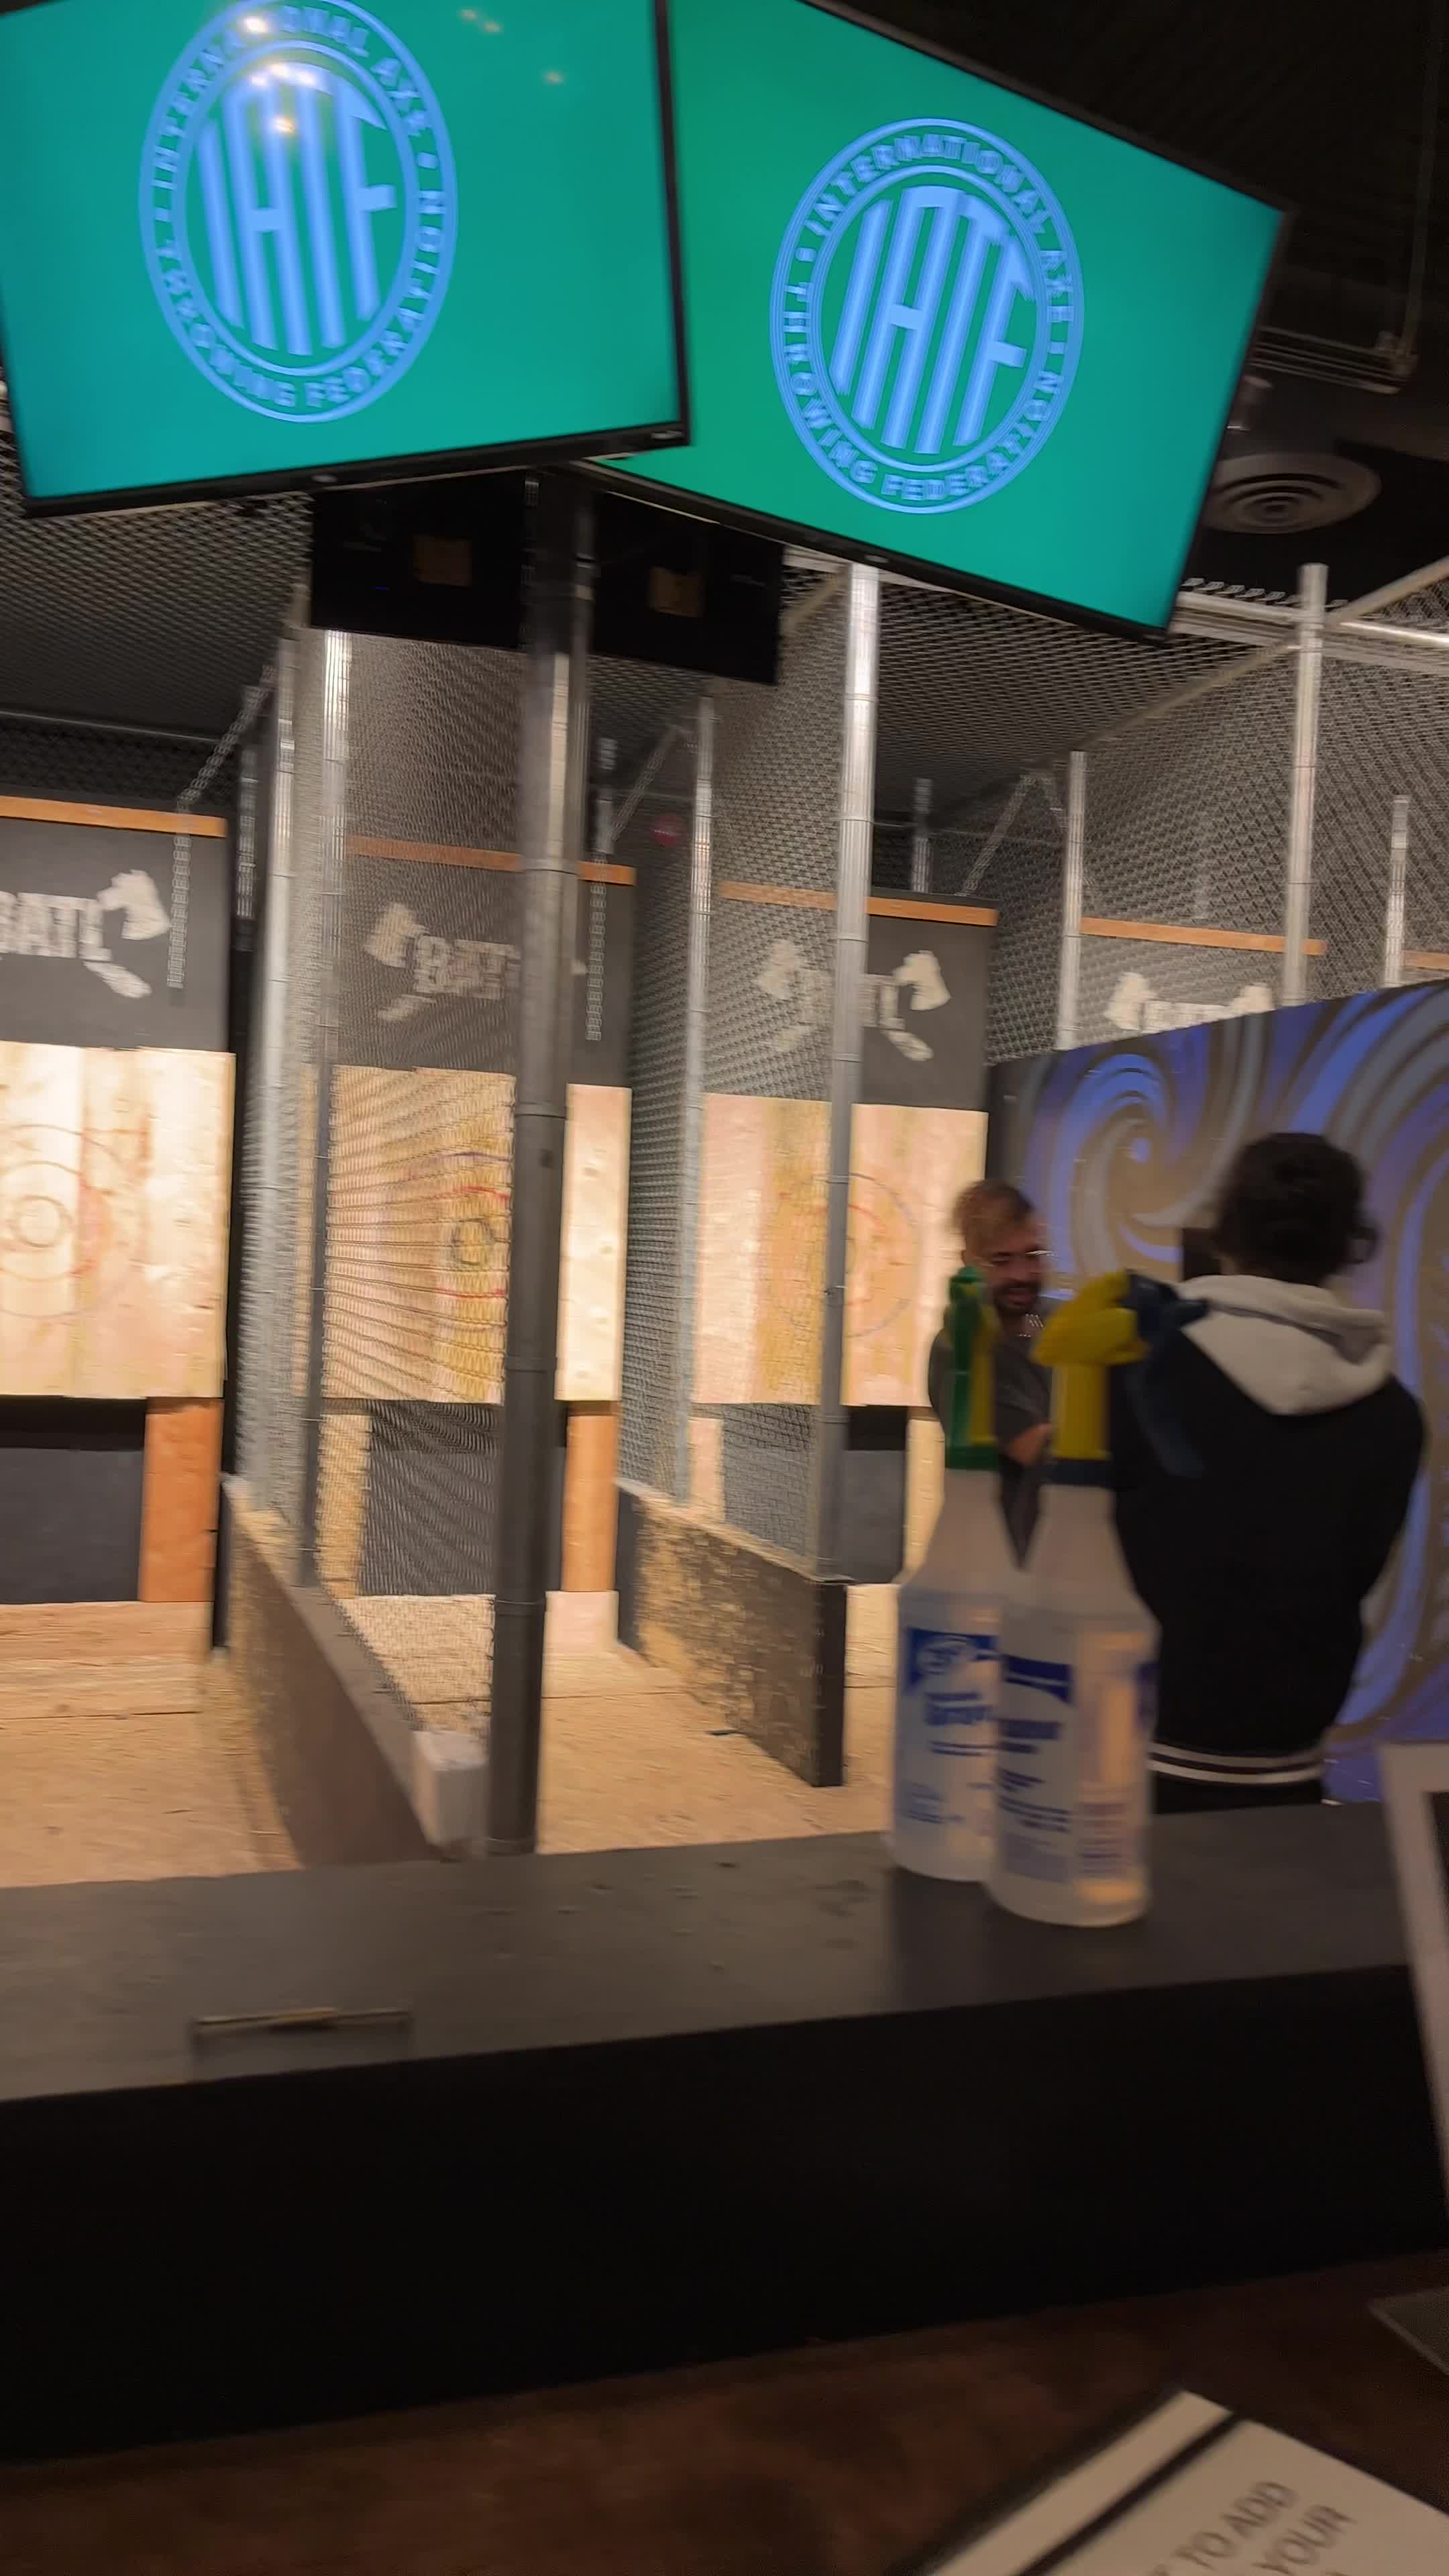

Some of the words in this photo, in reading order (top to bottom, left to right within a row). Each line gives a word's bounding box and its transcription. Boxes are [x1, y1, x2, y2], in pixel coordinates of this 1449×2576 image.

[150, 5, 370, 191] INTERNAONAL
[804, 134, 1052, 236] INTERNATIONAL
[1040, 250, 1075, 323] AXE
[784, 280, 879, 484] THROWING
[880, 370, 1063, 501] FEDERATION
[1221, 2481, 1300, 2538] ADD
